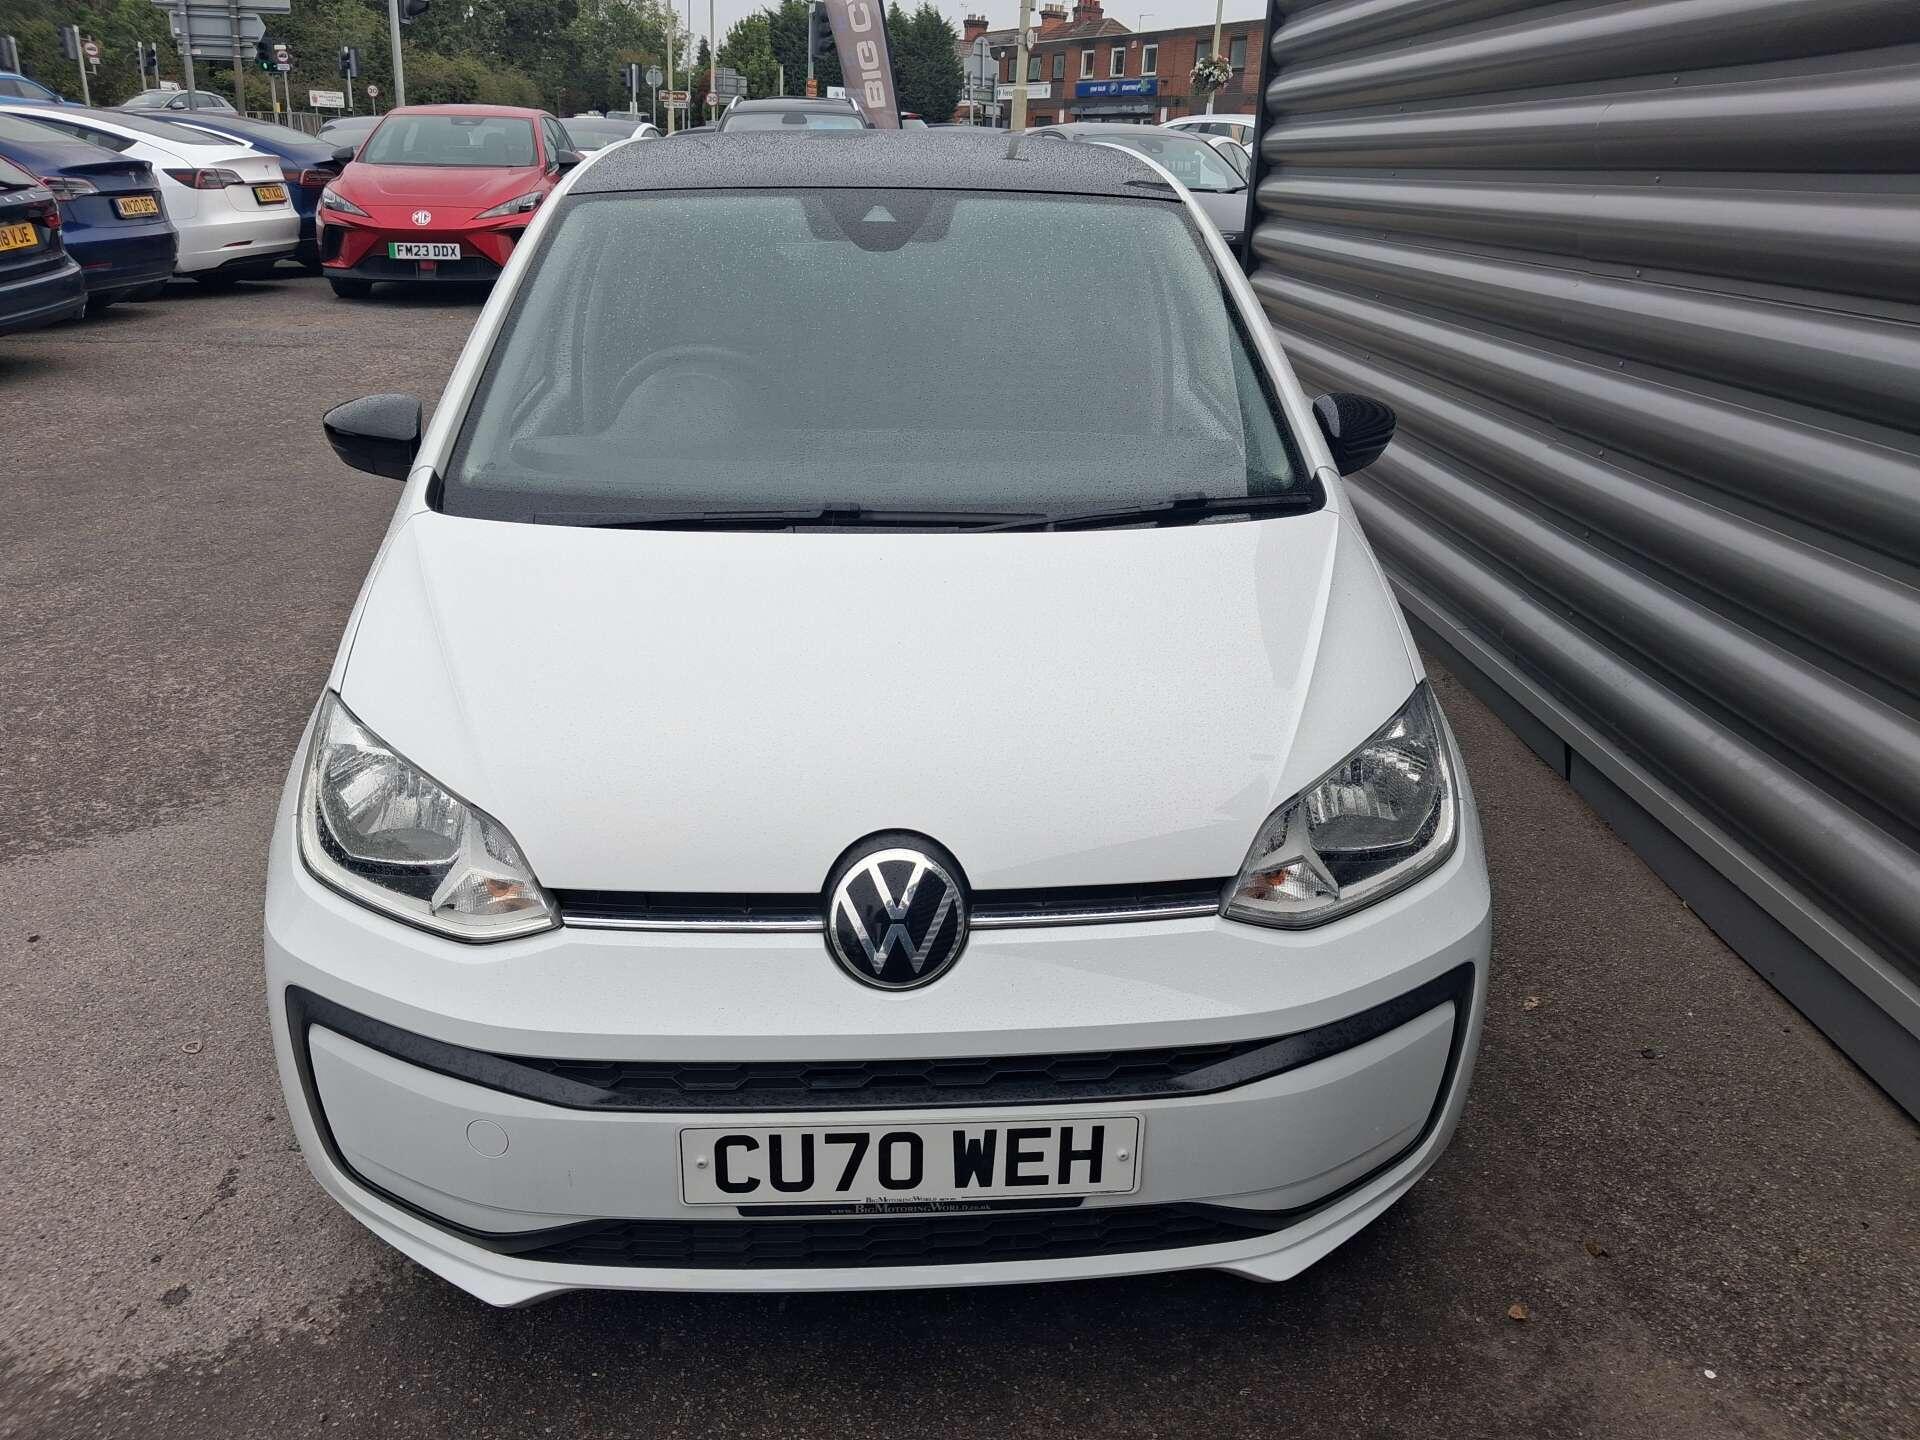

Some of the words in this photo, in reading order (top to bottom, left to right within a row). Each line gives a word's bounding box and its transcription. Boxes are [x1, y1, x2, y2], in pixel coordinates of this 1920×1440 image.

[846, 0, 872, 33] C
[856, 40, 886, 109] BIG
[412, 210, 432, 226] MG
[10, 226, 31, 245] VJE
[397, 244, 430, 257] FM23
[433, 245, 457, 257] DDX
[834, 850, 961, 981] VW
[713, 1130, 923, 1195] CU70
[952, 1125, 1106, 1189] WEH
